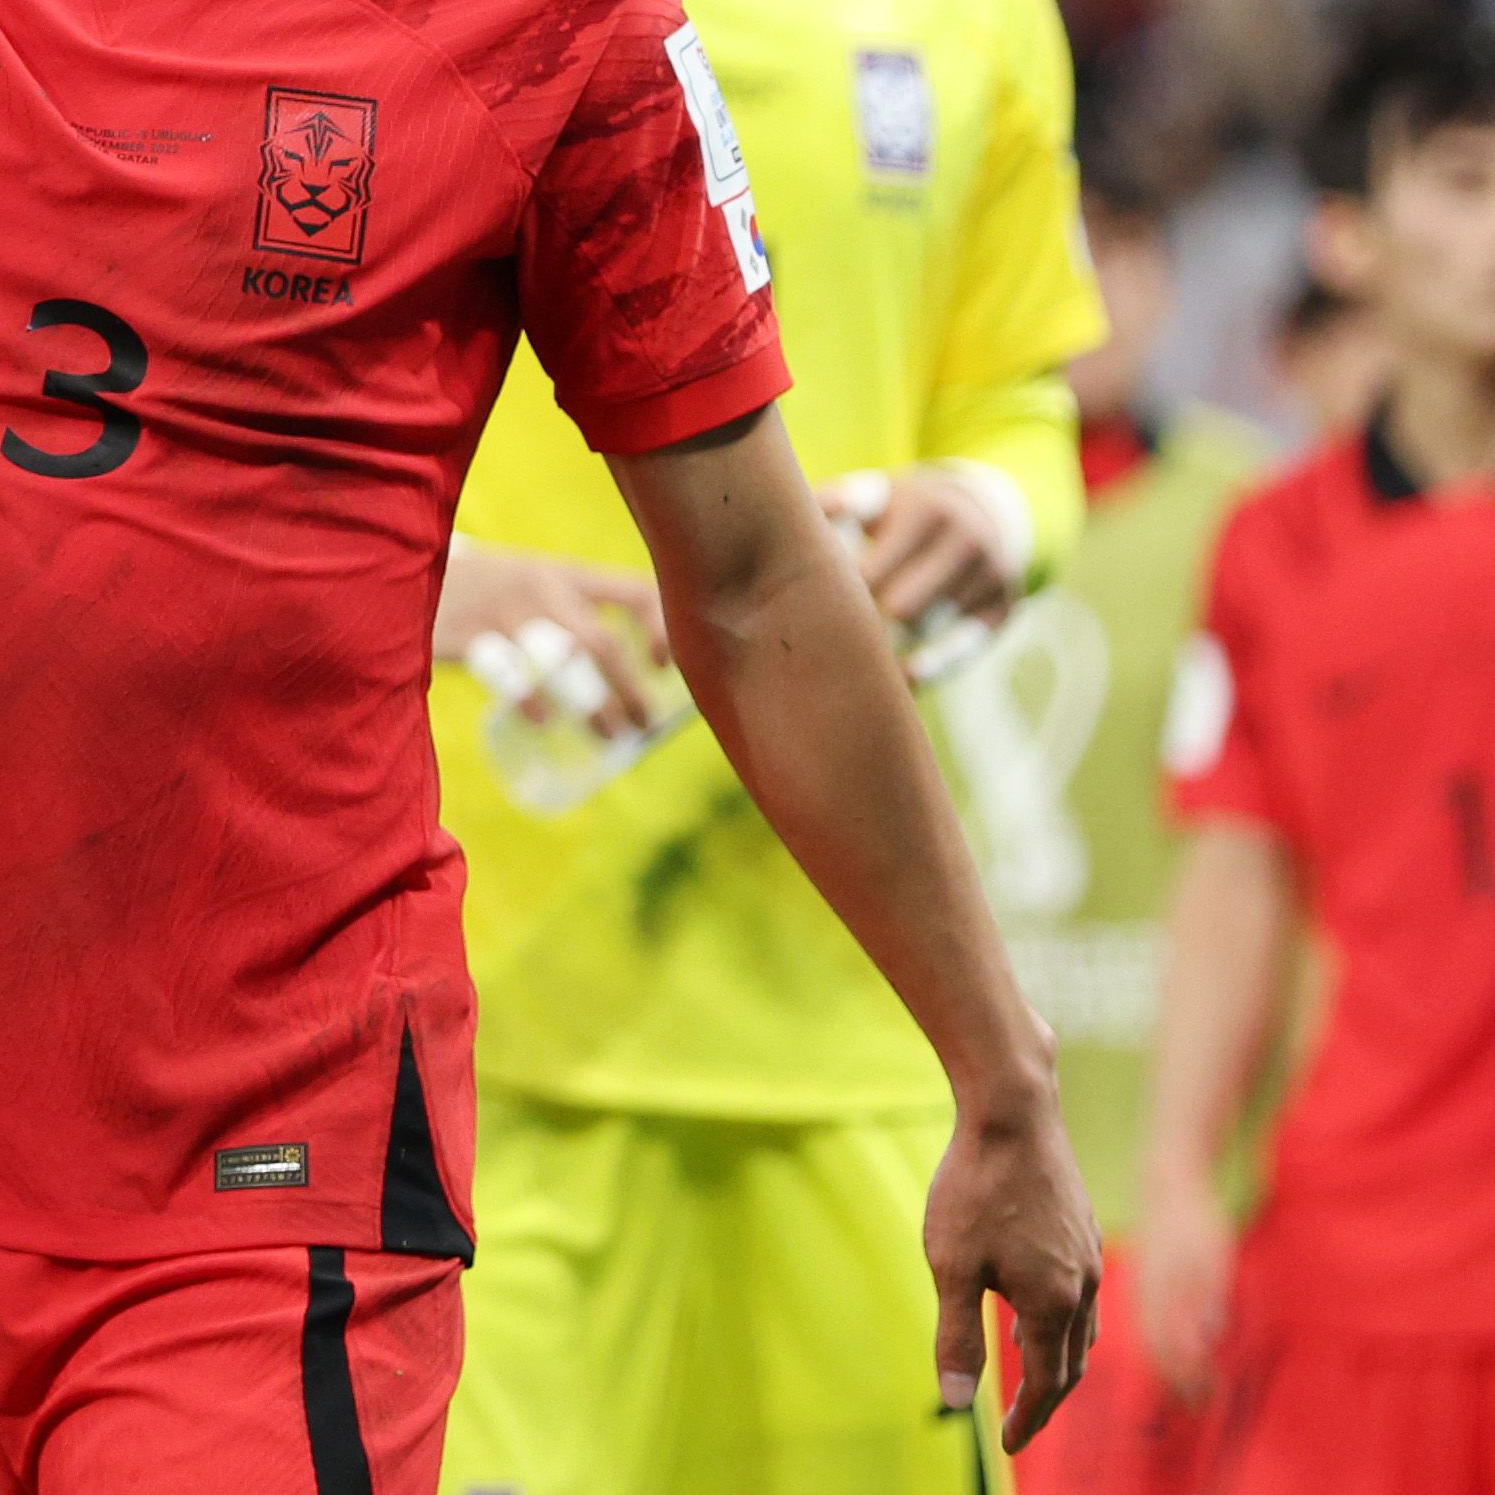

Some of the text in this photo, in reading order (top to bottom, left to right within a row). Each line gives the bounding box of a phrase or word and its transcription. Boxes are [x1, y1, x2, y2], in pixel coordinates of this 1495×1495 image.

[117, 153, 159, 165] QATAR
[242, 266, 354, 306] KOREA
[0, 298, 148, 479] 3
